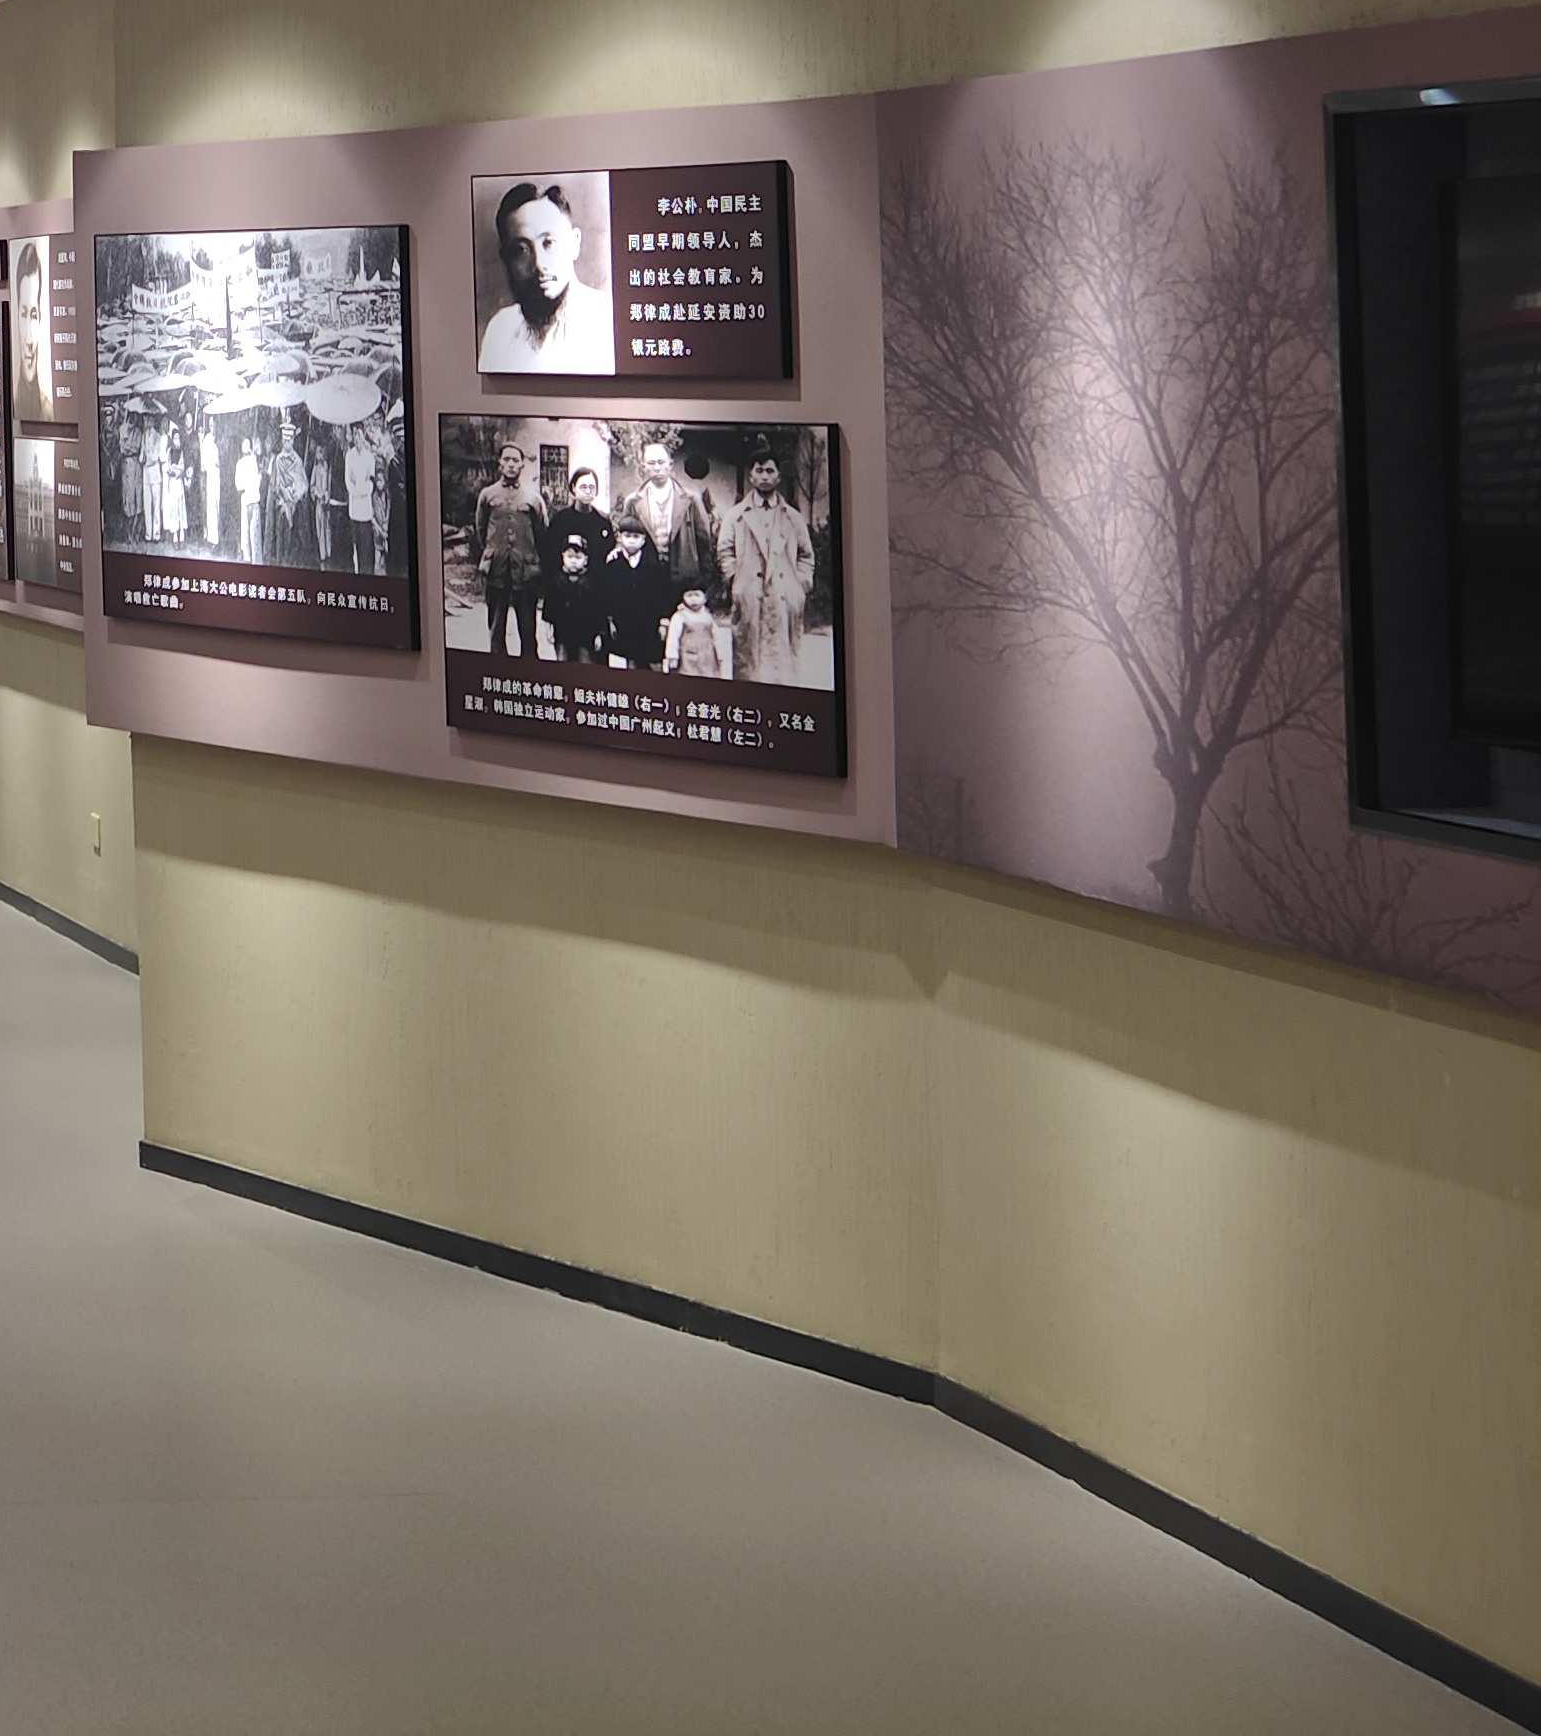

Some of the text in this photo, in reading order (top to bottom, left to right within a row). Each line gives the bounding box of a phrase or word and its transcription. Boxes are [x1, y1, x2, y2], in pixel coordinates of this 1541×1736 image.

[630, 267, 762, 286] 出的社会教育家。为
[630, 303, 764, 321] 郑律成赴延安资助30
